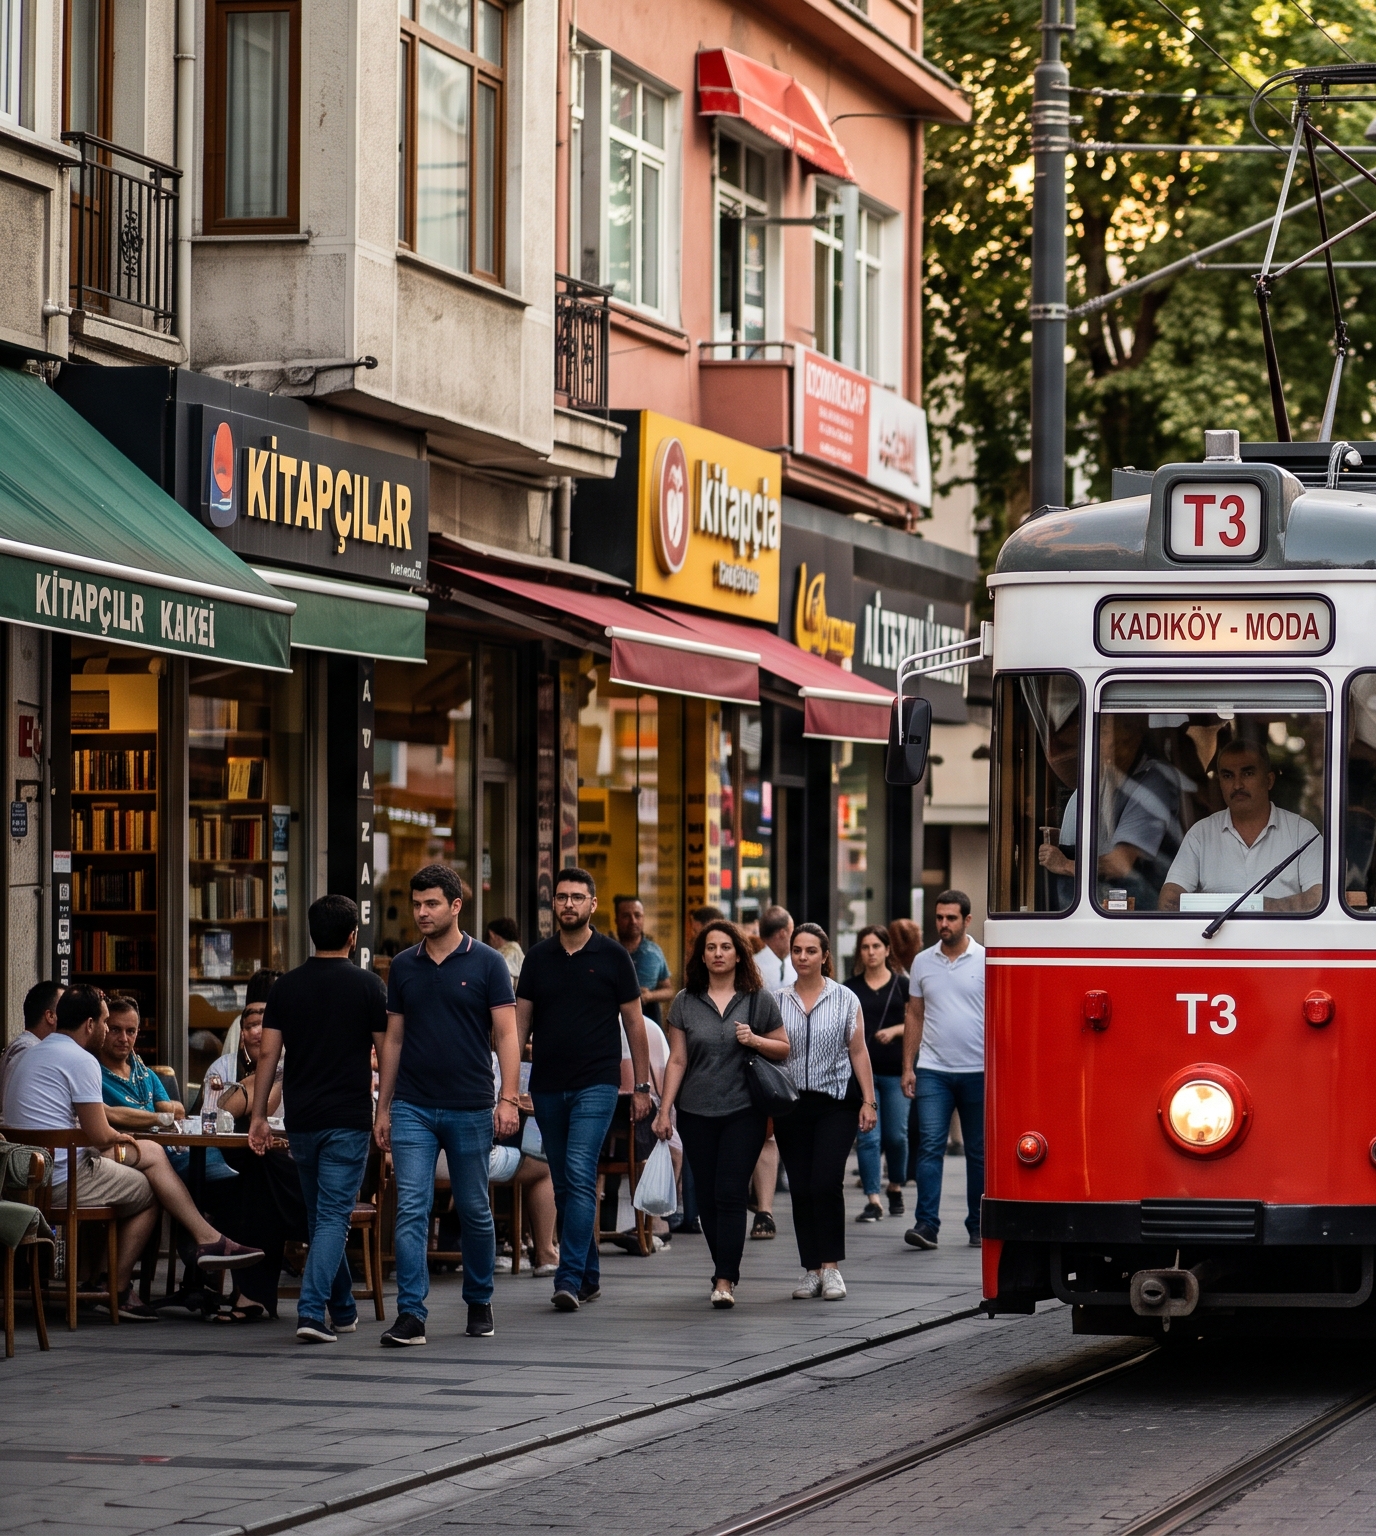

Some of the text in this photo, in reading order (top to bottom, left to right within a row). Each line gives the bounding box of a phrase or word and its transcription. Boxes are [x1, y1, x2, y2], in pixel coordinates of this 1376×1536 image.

[247, 435, 412, 554] KİTAPÇILAR
[1183, 494, 1247, 547] T3
[35, 569, 145, 635] KİTAPÇILR
[1109, 605, 1321, 641] KADIKÖY - MODA
[1175, 993, 1238, 1036] T3
